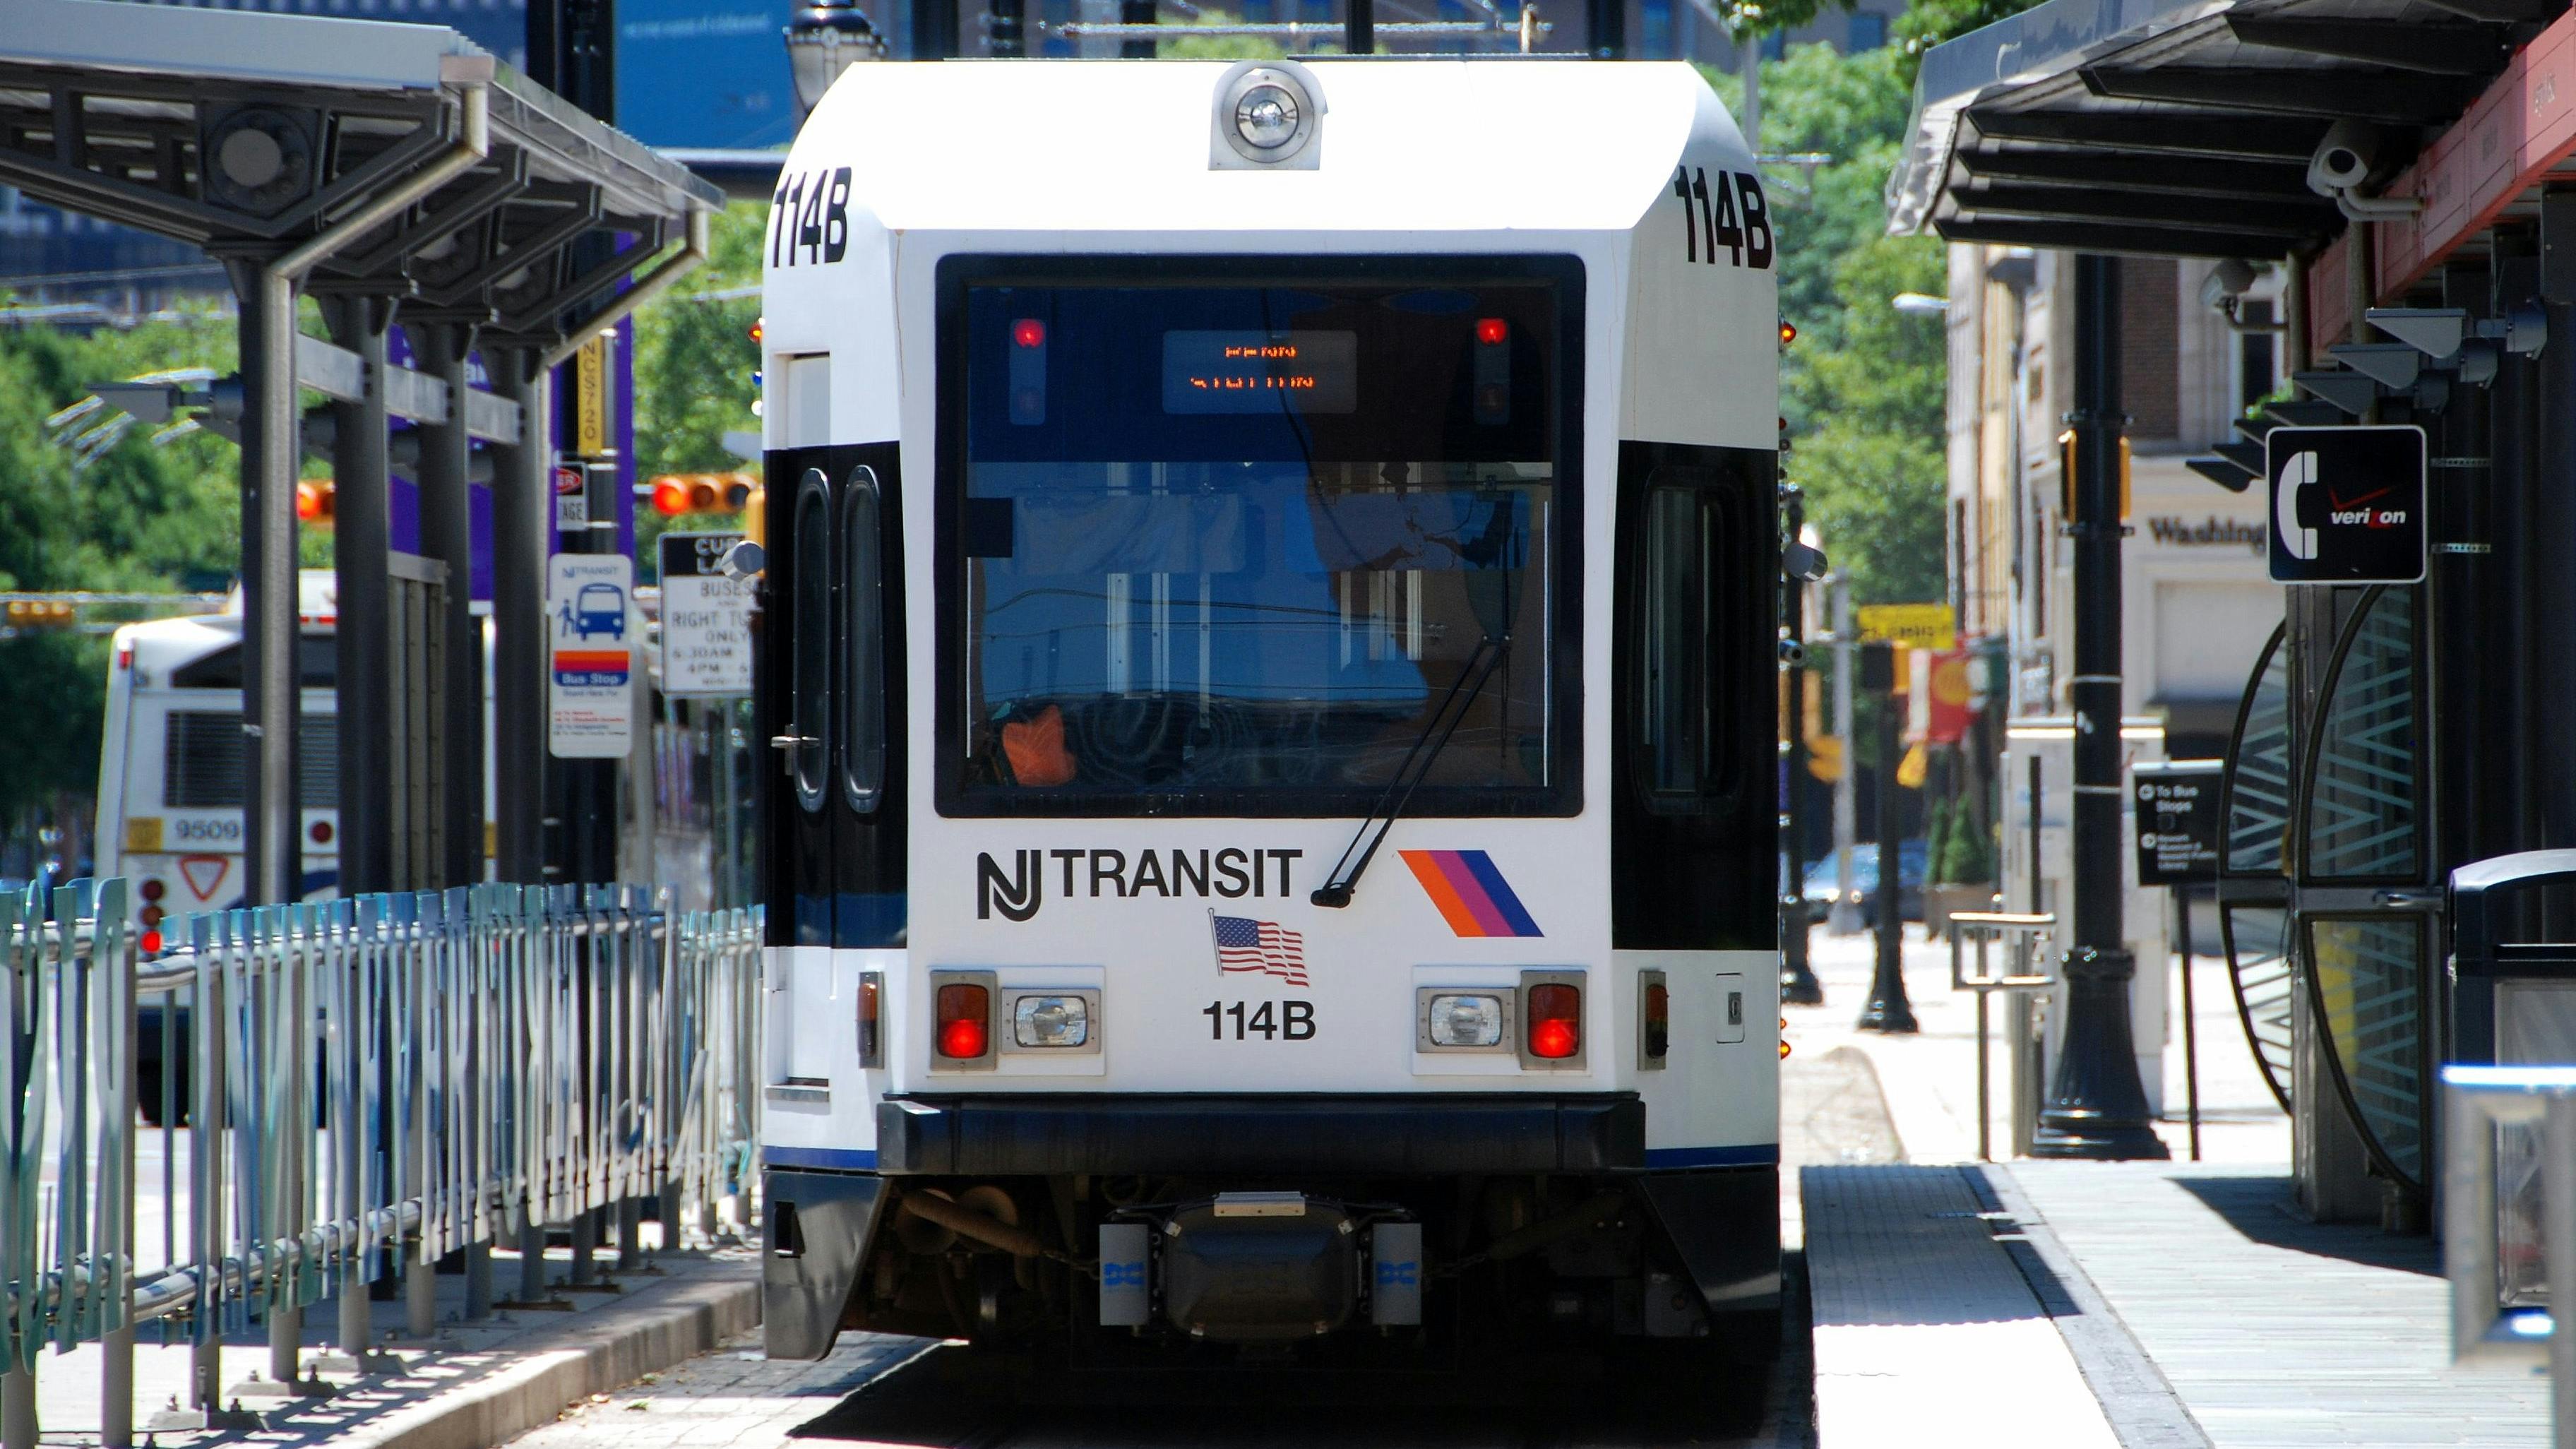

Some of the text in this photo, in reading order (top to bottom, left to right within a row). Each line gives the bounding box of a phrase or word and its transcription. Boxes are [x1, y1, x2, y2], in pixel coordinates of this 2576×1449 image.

[773, 167, 852, 268] 114B
[1674, 165, 1772, 270] 114B
[2331, 508, 2407, 529] verizon
[576, 566, 619, 575] TRANSIT
[700, 581, 752, 597] BUSES
[672, 612, 717, 627] RIGHT
[706, 631, 749, 643] ONLY
[562, 673, 619, 686] Bus Stop
[177, 819, 239, 839] 9509
[1051, 849, 1303, 898] TRANSIT
[1203, 1001, 1316, 1041] 114B
